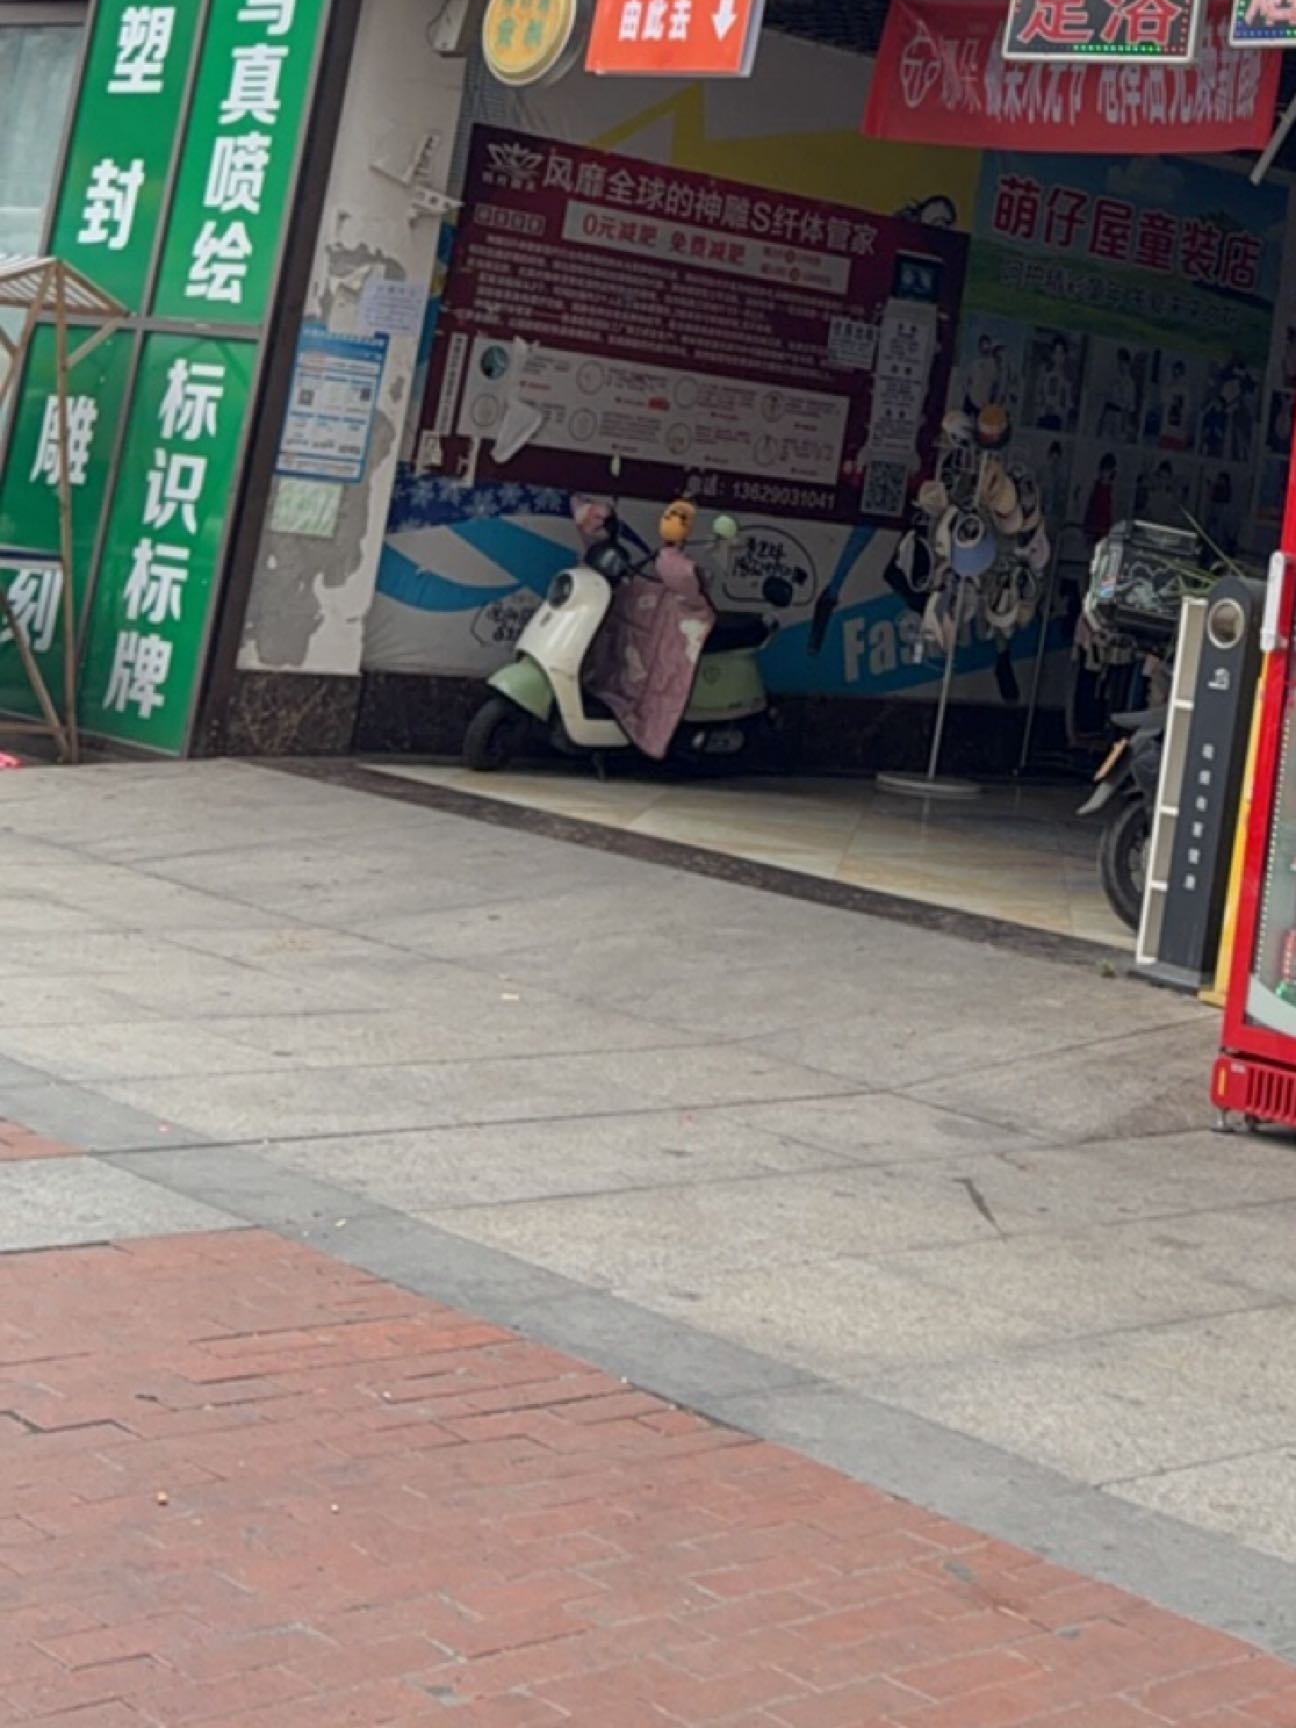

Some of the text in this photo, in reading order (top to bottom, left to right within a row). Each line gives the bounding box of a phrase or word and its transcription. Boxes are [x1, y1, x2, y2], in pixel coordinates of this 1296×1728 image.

[77, 5, 178, 251] 塑封
[991, 174, 1264, 293] 萌仔屋童装店
[1, 393, 99, 653] 雕刻
[103, 358, 227, 719] 标识标牌
